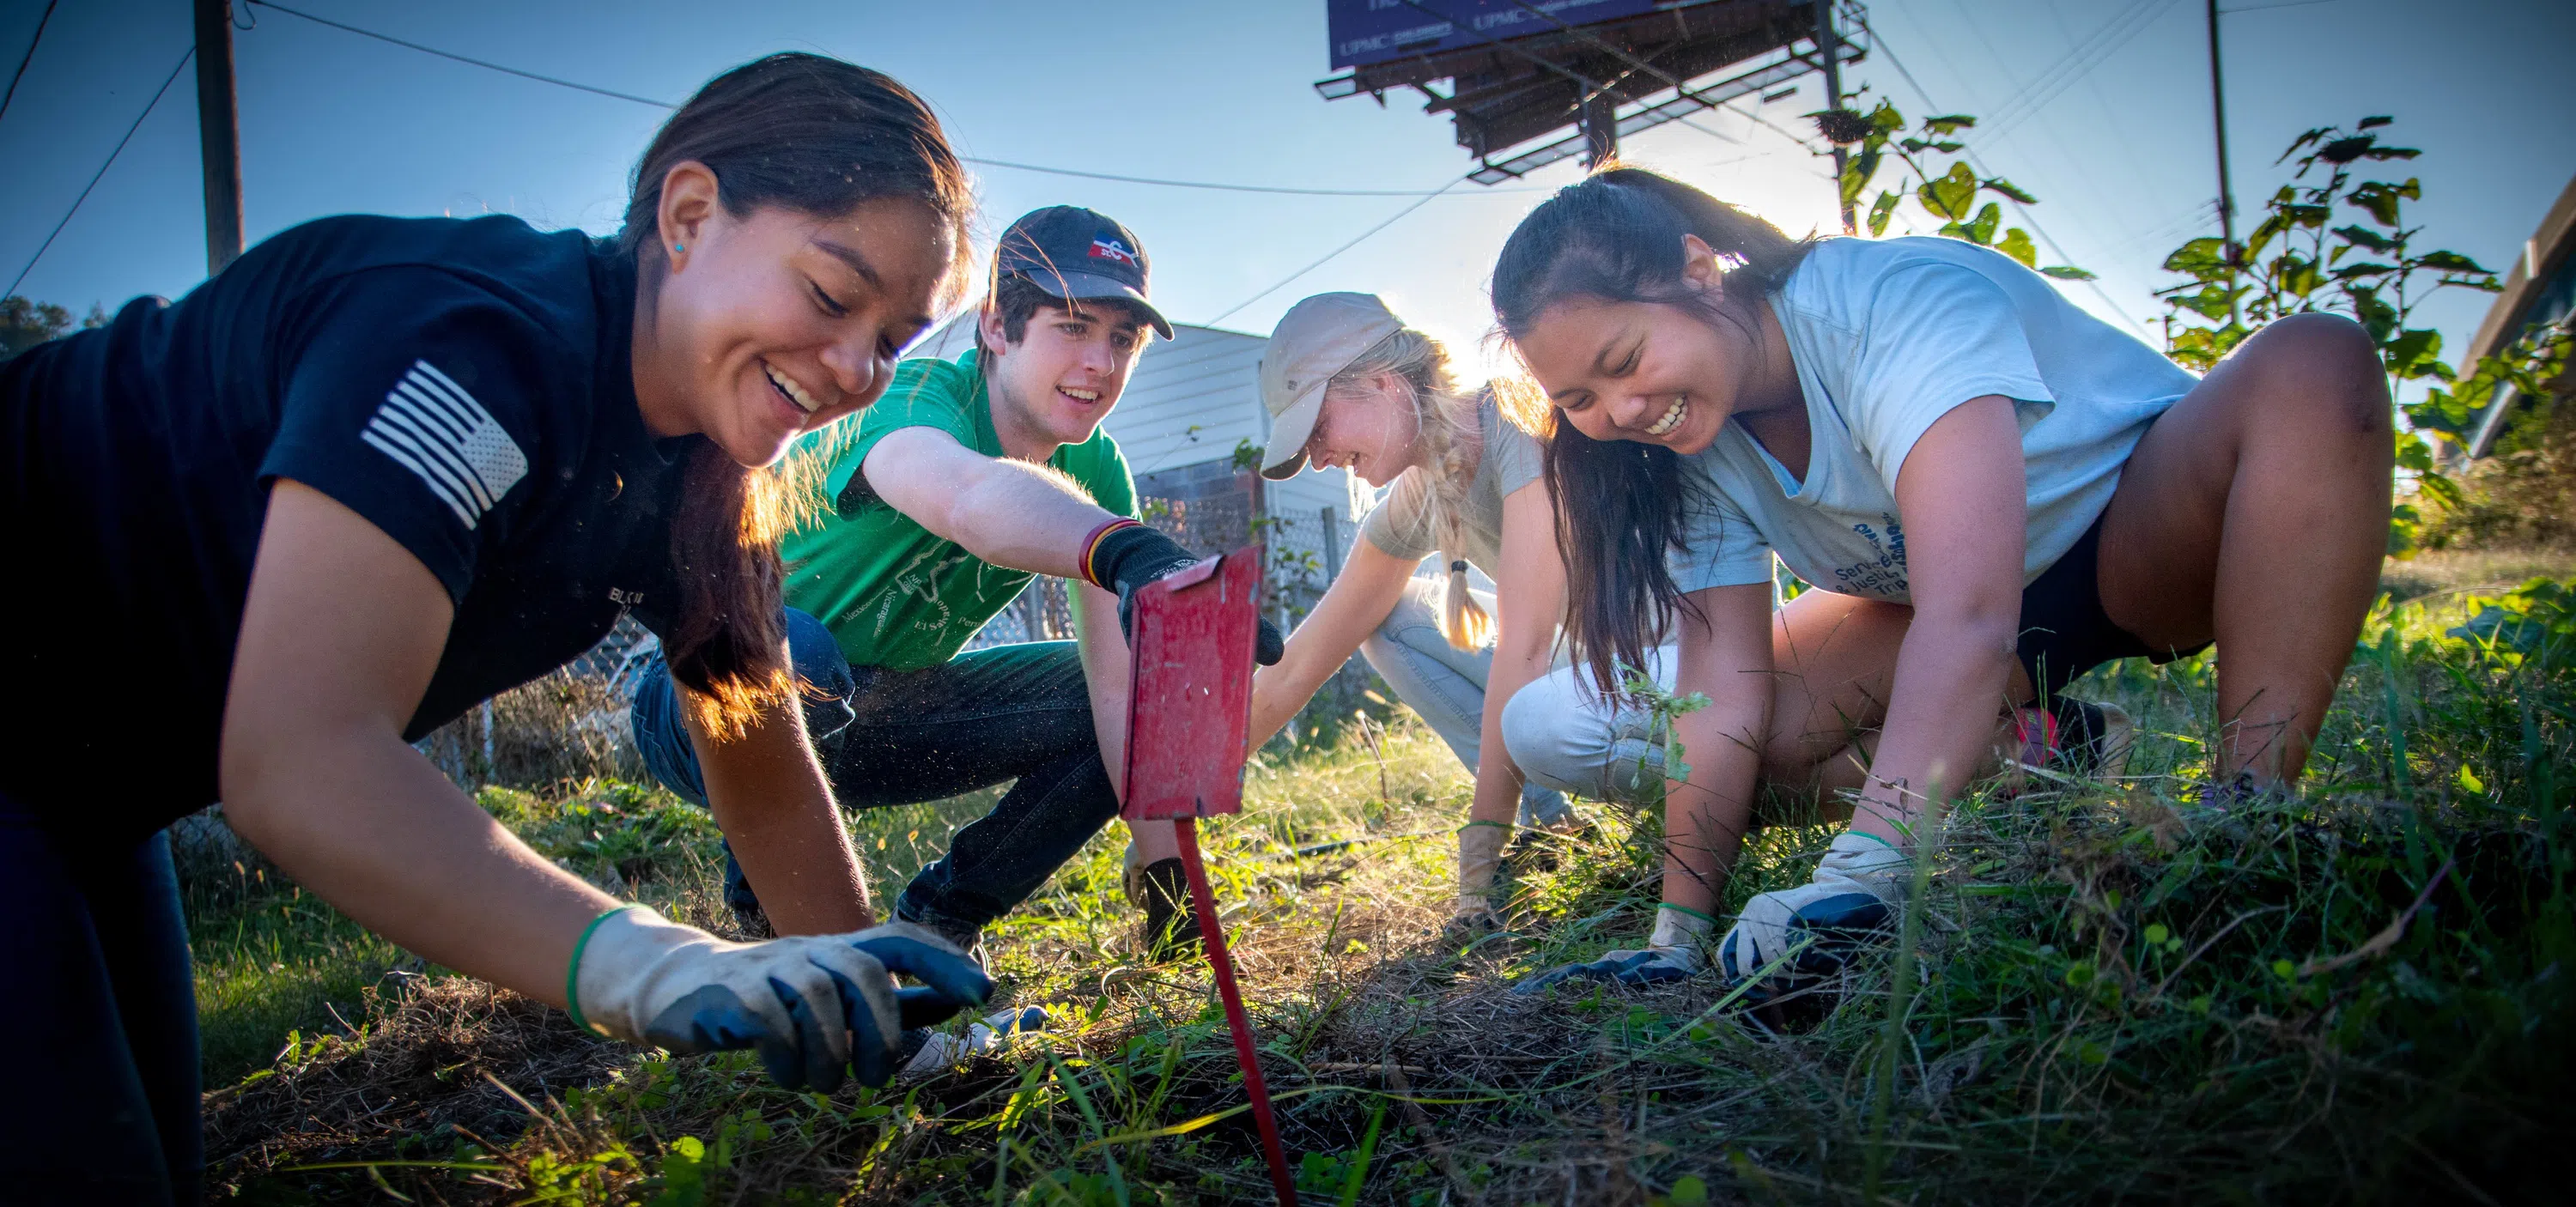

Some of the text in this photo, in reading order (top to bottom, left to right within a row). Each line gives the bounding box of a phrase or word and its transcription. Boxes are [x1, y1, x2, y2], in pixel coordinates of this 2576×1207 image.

[1473, 8, 1528, 31] UPMC
[1340, 33, 1389, 57] UPMC
[1835, 555, 1892, 581] Servce
